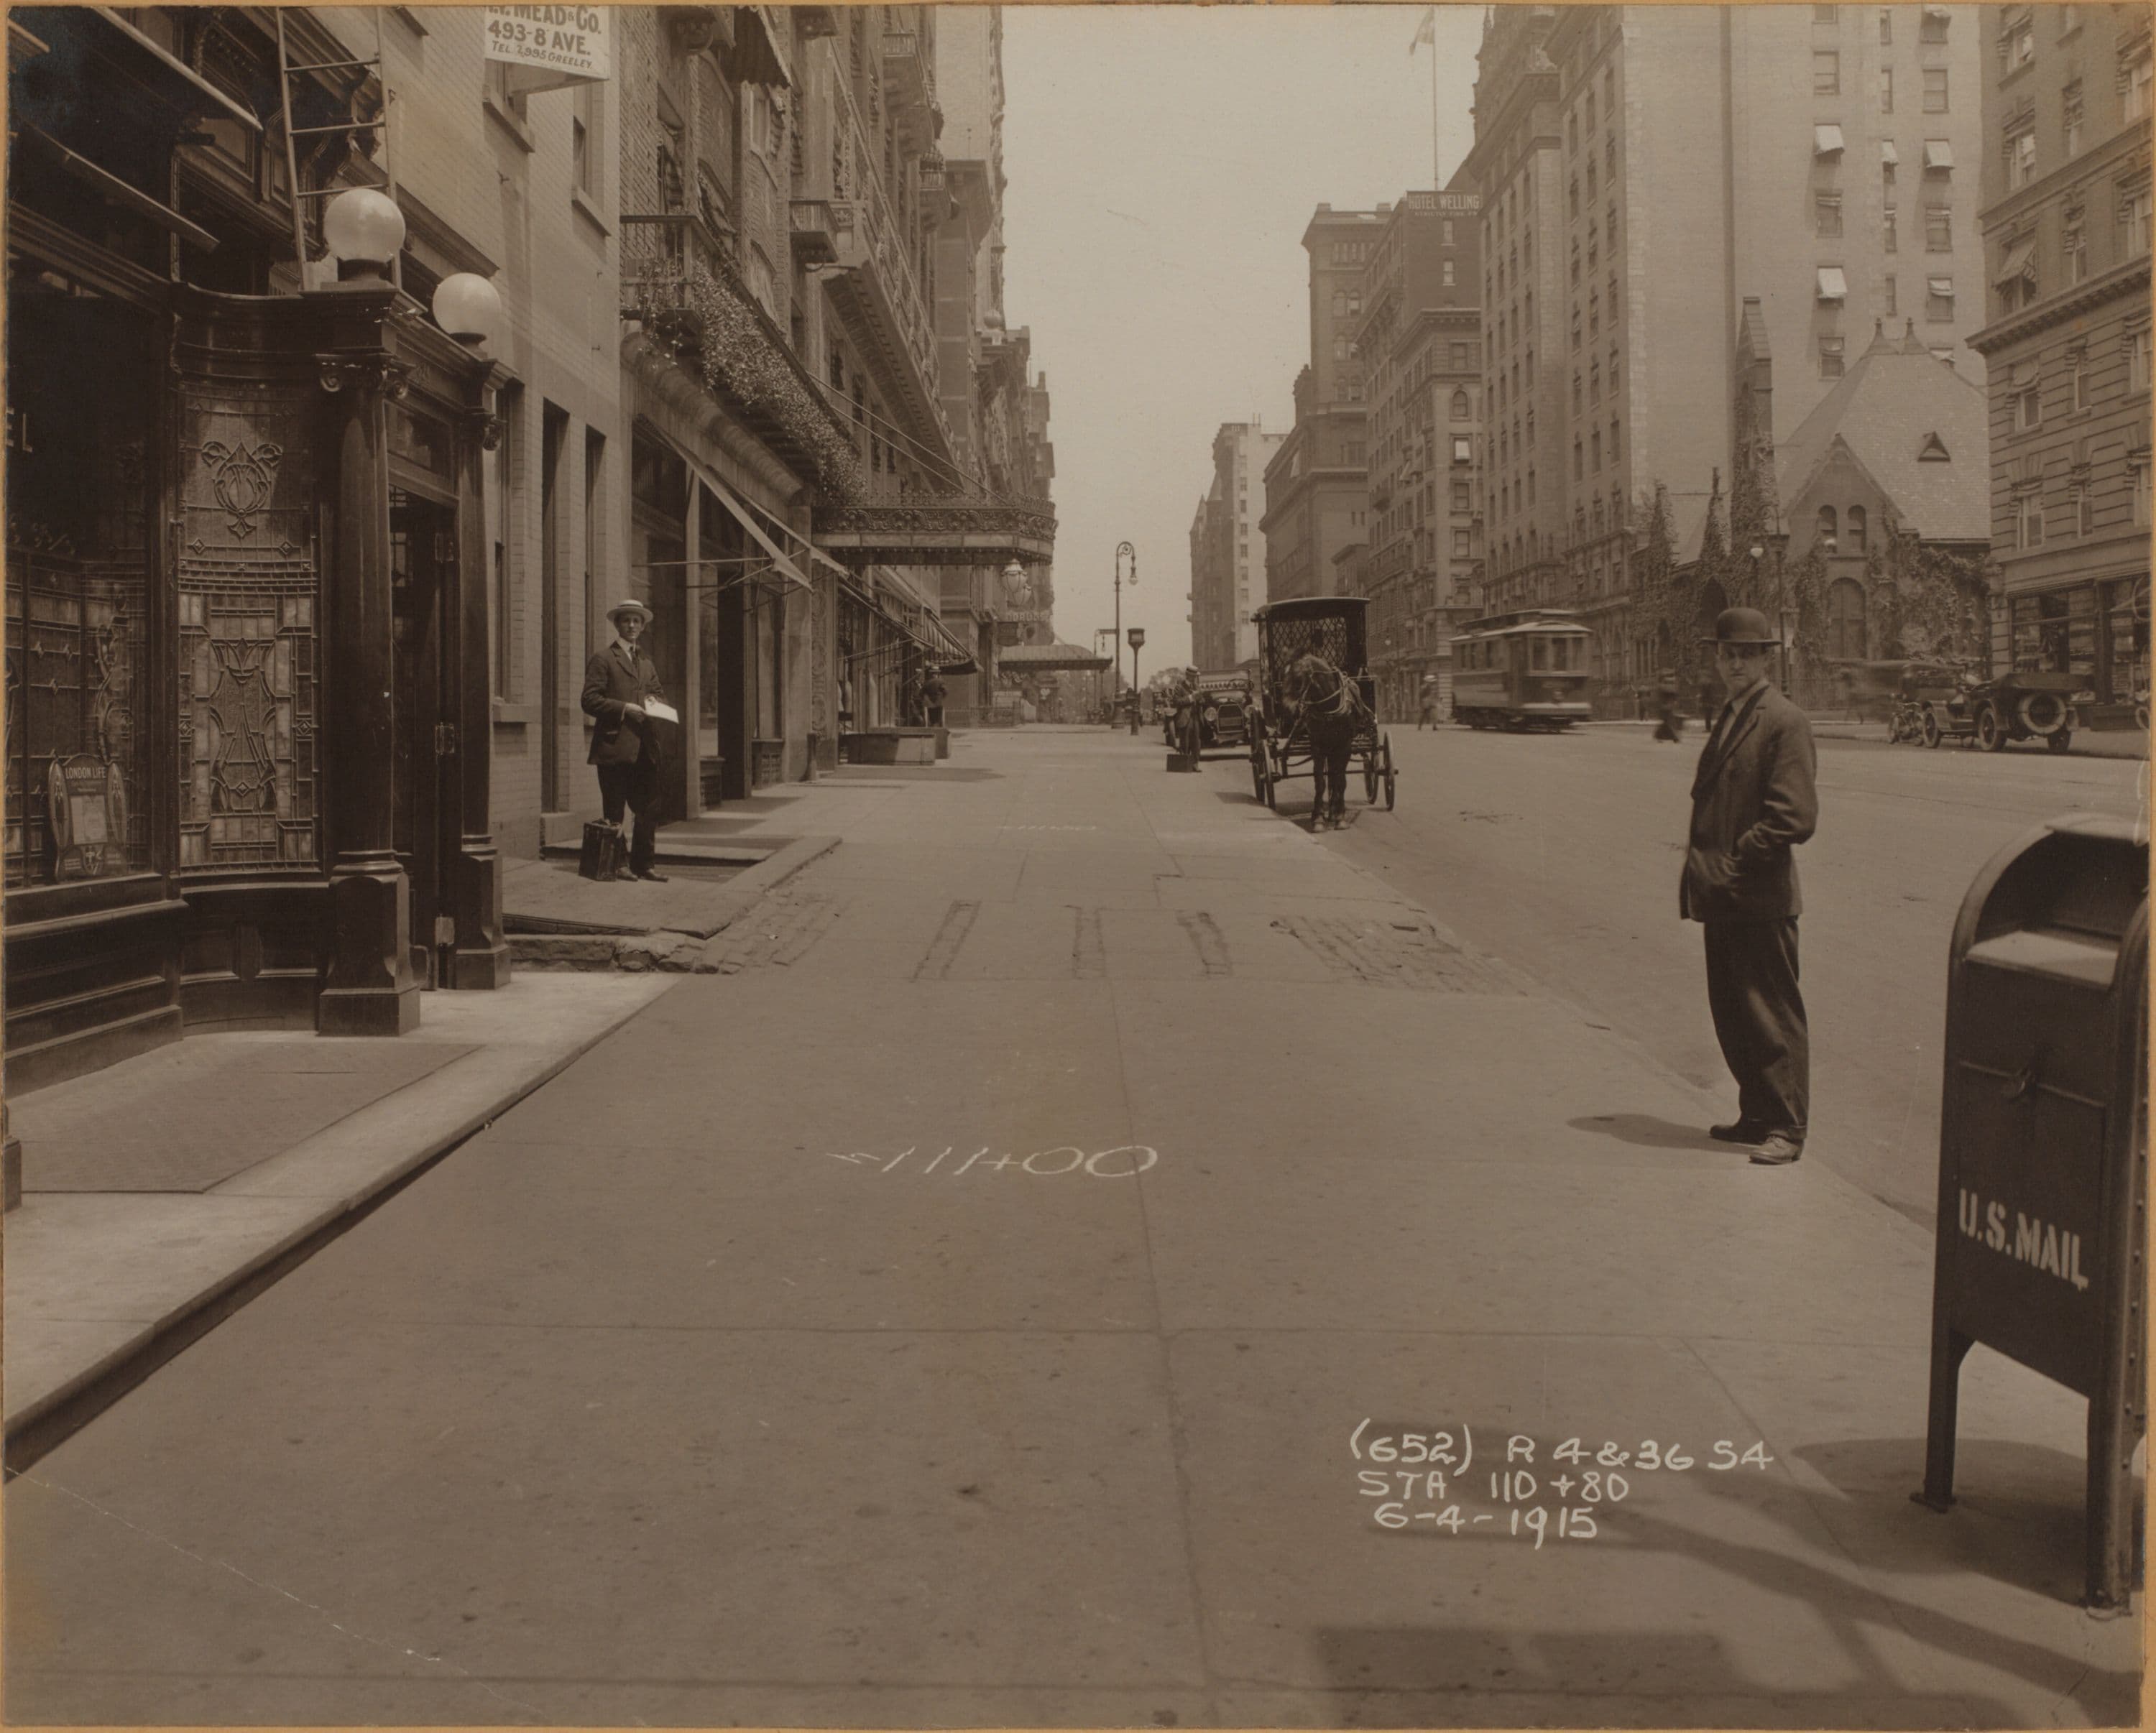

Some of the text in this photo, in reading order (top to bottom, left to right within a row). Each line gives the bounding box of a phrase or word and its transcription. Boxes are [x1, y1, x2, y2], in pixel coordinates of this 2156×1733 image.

[514, 6, 566, 26] MEAD
[552, 32, 591, 55] AVE.
[1409, 195, 1437, 210] HOTEL
[65, 766, 106, 780] LONDON LIFE
[1959, 1188, 2089, 1292] U.S. MAIL
